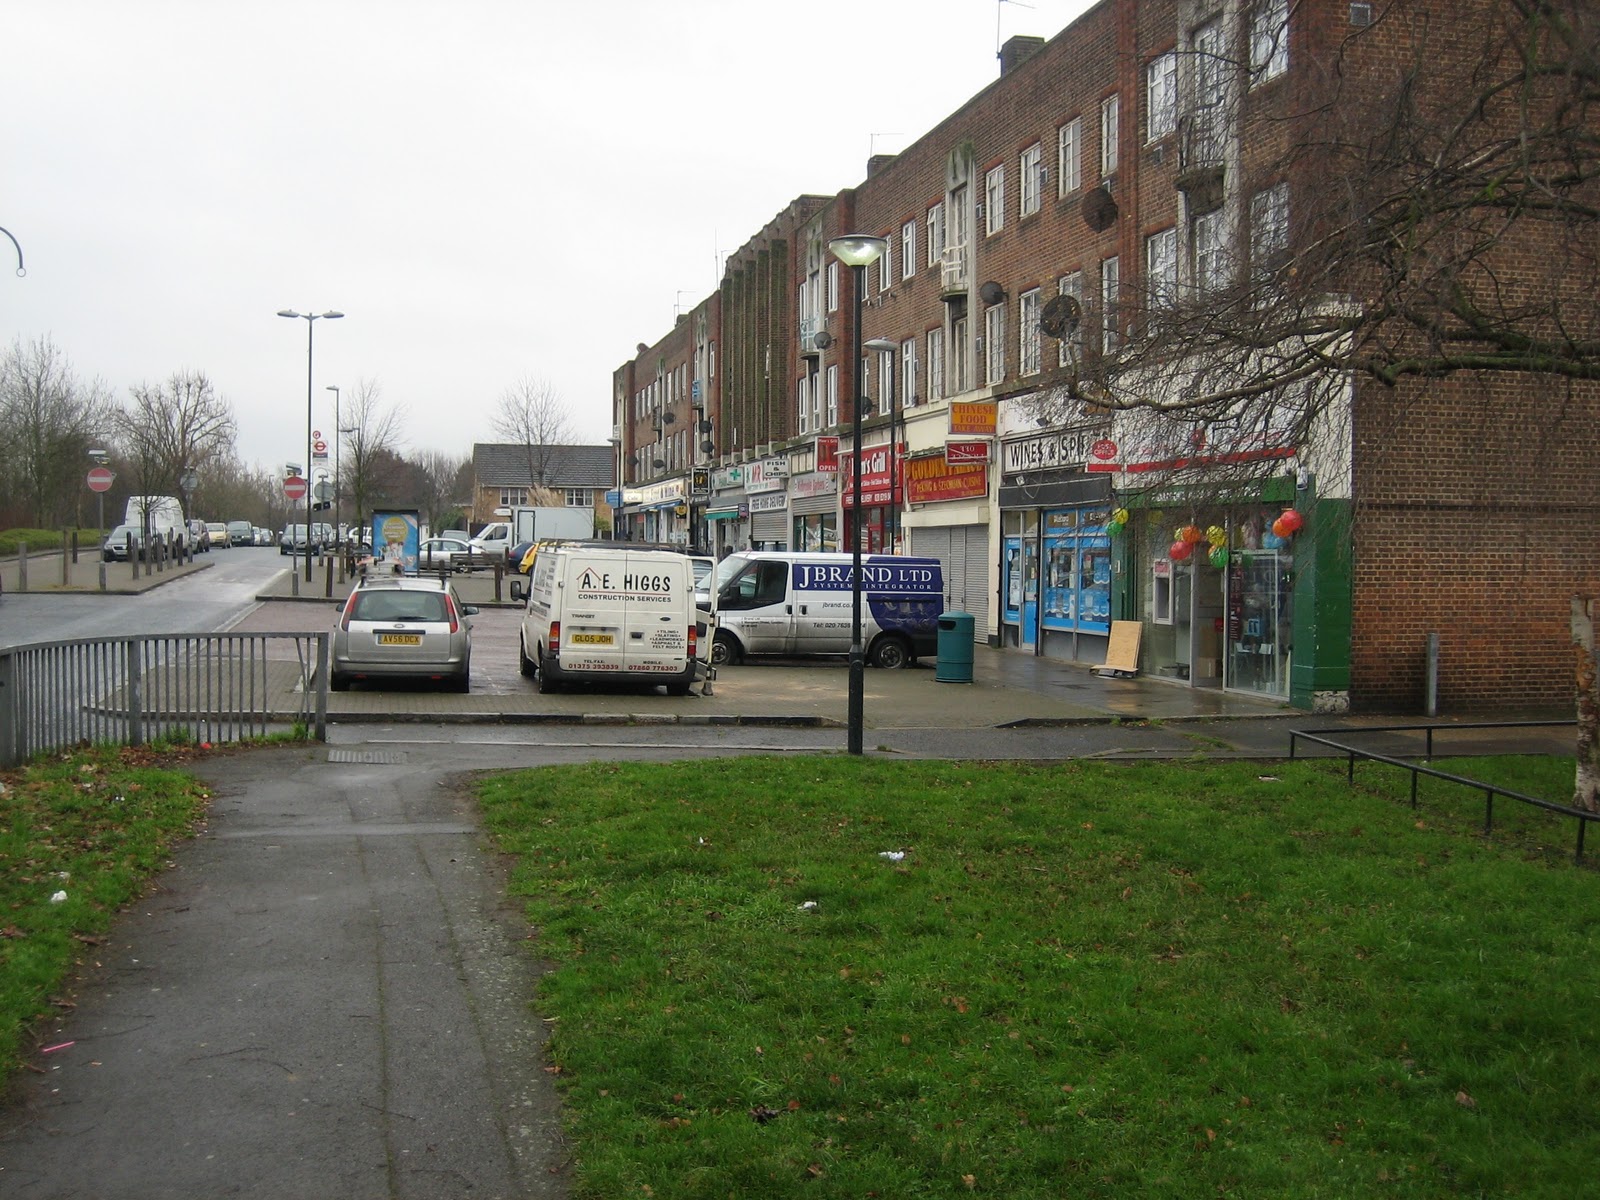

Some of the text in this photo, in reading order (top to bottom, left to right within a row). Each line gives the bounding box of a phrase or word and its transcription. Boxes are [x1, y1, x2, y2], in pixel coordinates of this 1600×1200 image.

[952, 405, 993, 414] CHINESE
[960, 415, 987, 424] FOOD
[954, 425, 970, 433] TAKE
[1010, 442, 1044, 467] WINES
[1048, 442, 1056, 461] &
[871, 451, 886, 473] Grill
[911, 457, 947, 480] GOLDEN
[899, 569, 932, 582] LTD
[624, 573, 671, 592] HIGGS
[578, 593, 672, 603] CONSTRUCTION SERVICES
[383, 635, 419, 643] AV56 DCX
